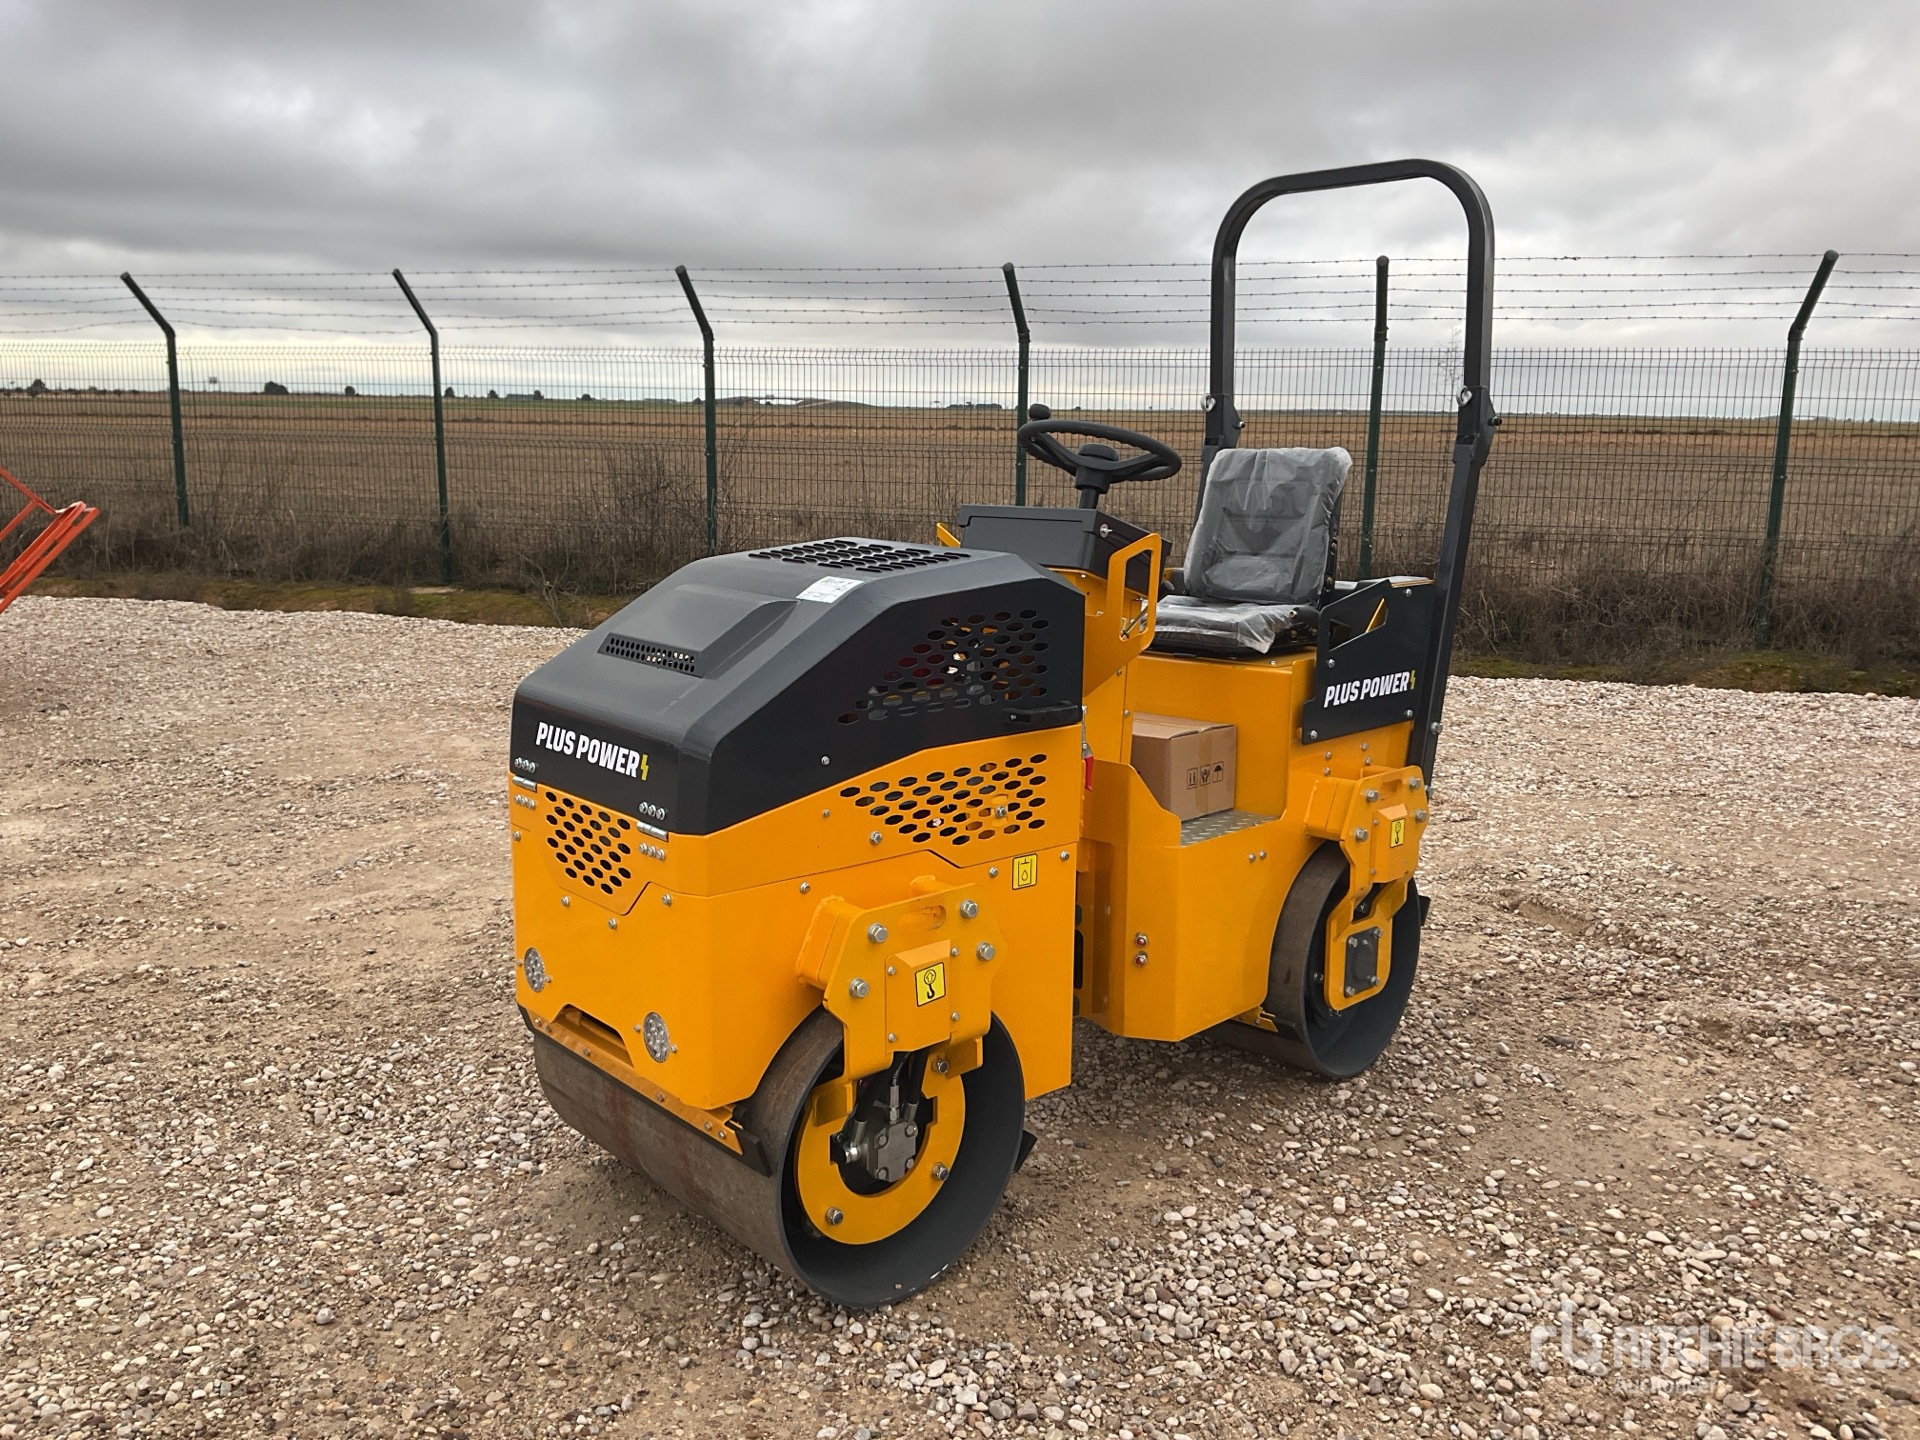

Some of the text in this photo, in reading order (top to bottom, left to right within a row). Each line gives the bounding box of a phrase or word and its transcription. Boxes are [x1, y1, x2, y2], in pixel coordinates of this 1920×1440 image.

[1323, 671, 1411, 708] PLUS POWER
[535, 721, 640, 778] PLUS POWER
